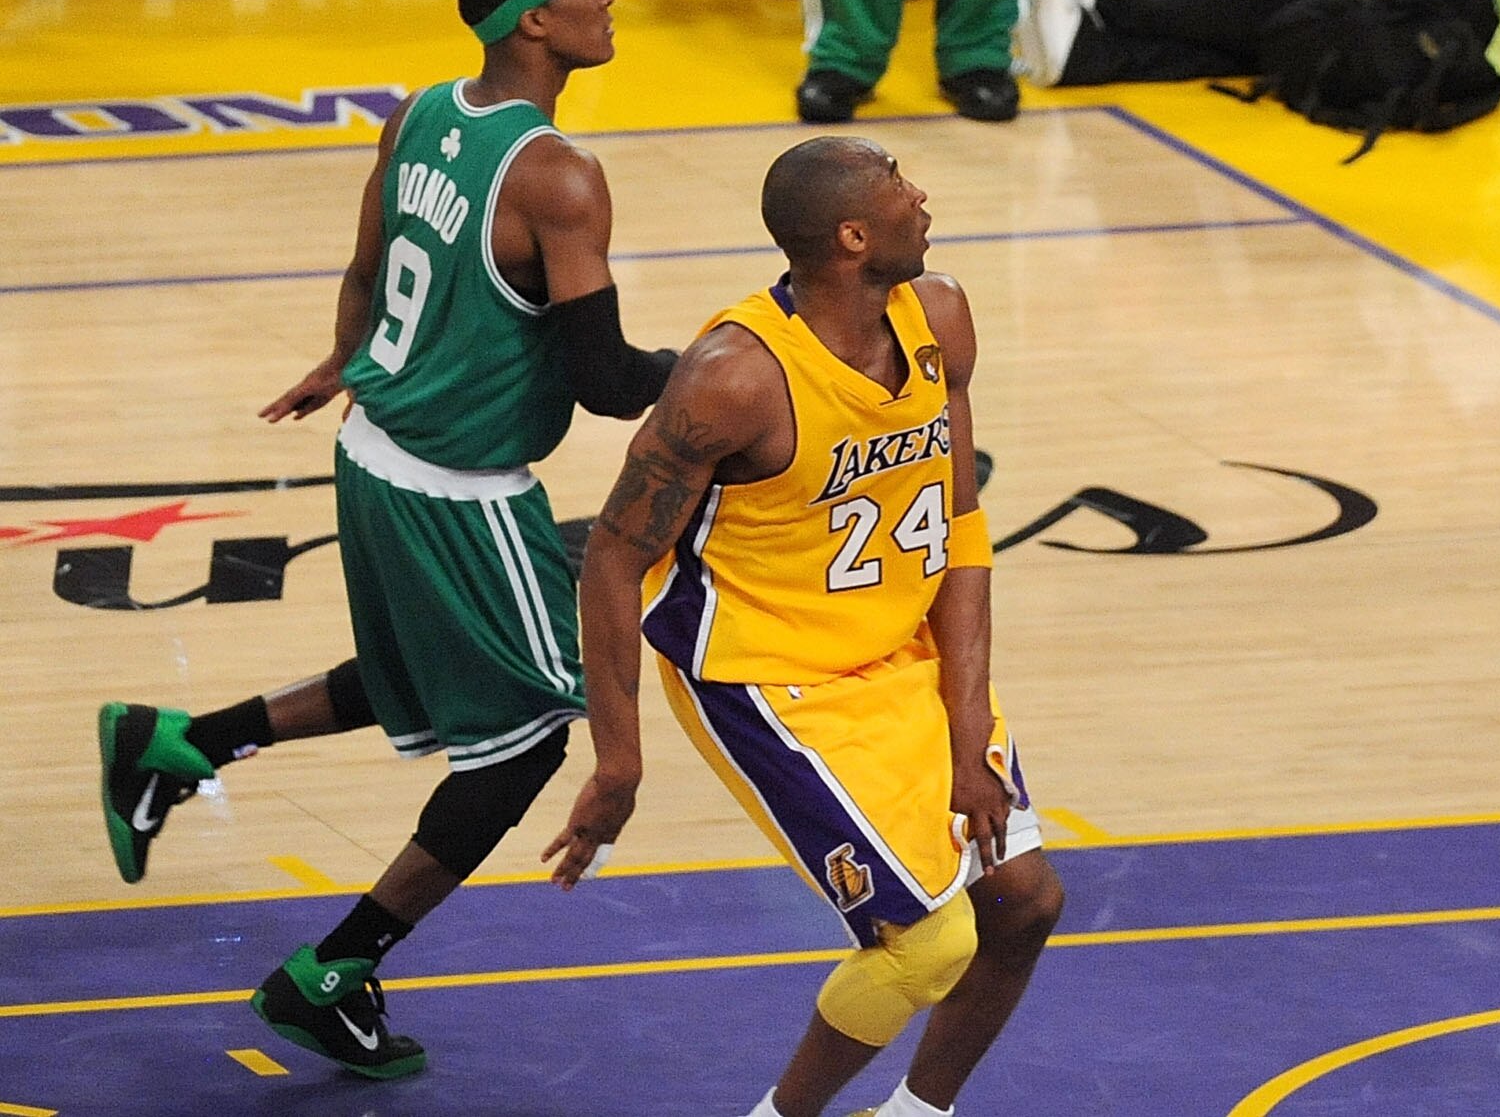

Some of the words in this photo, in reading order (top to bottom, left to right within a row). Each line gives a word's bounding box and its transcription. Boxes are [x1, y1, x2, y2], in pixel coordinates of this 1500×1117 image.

[396, 162, 470, 246] RONDO
[368, 234, 433, 377] 9
[826, 481, 951, 594] 24
[320, 970, 342, 994] 9
